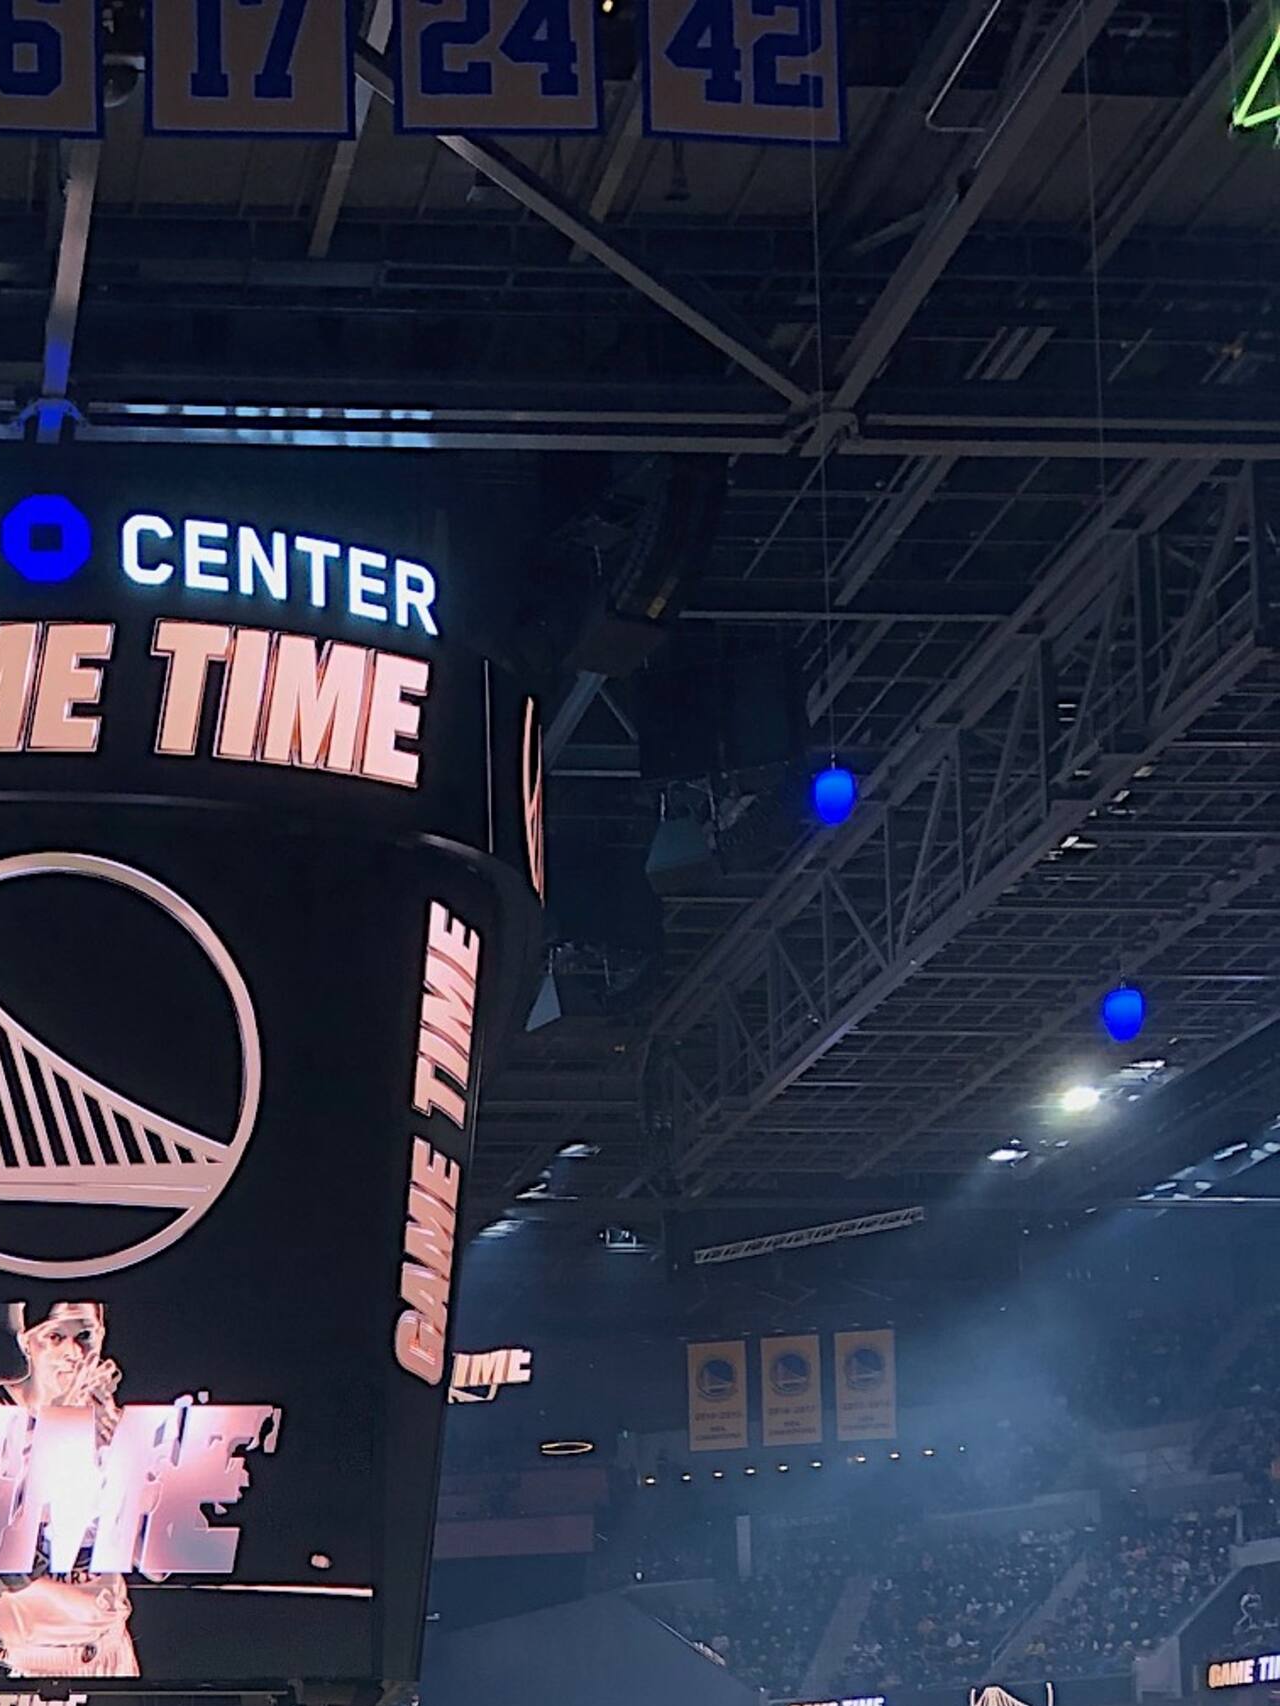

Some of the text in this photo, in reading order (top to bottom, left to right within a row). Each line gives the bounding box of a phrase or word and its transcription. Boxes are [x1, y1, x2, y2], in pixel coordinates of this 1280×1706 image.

[190, 0, 303, 98] 17
[420, 0, 579, 95] 24
[664, 0, 823, 108] 42
[120, 512, 440, 636] CENTER
[150, 617, 433, 788] TIME
[411, 900, 481, 1130] TIME
[395, 1134, 461, 1387] GAME
[454, 1350, 531, 1388] IME
[1208, 1658, 1255, 1688] GAME
